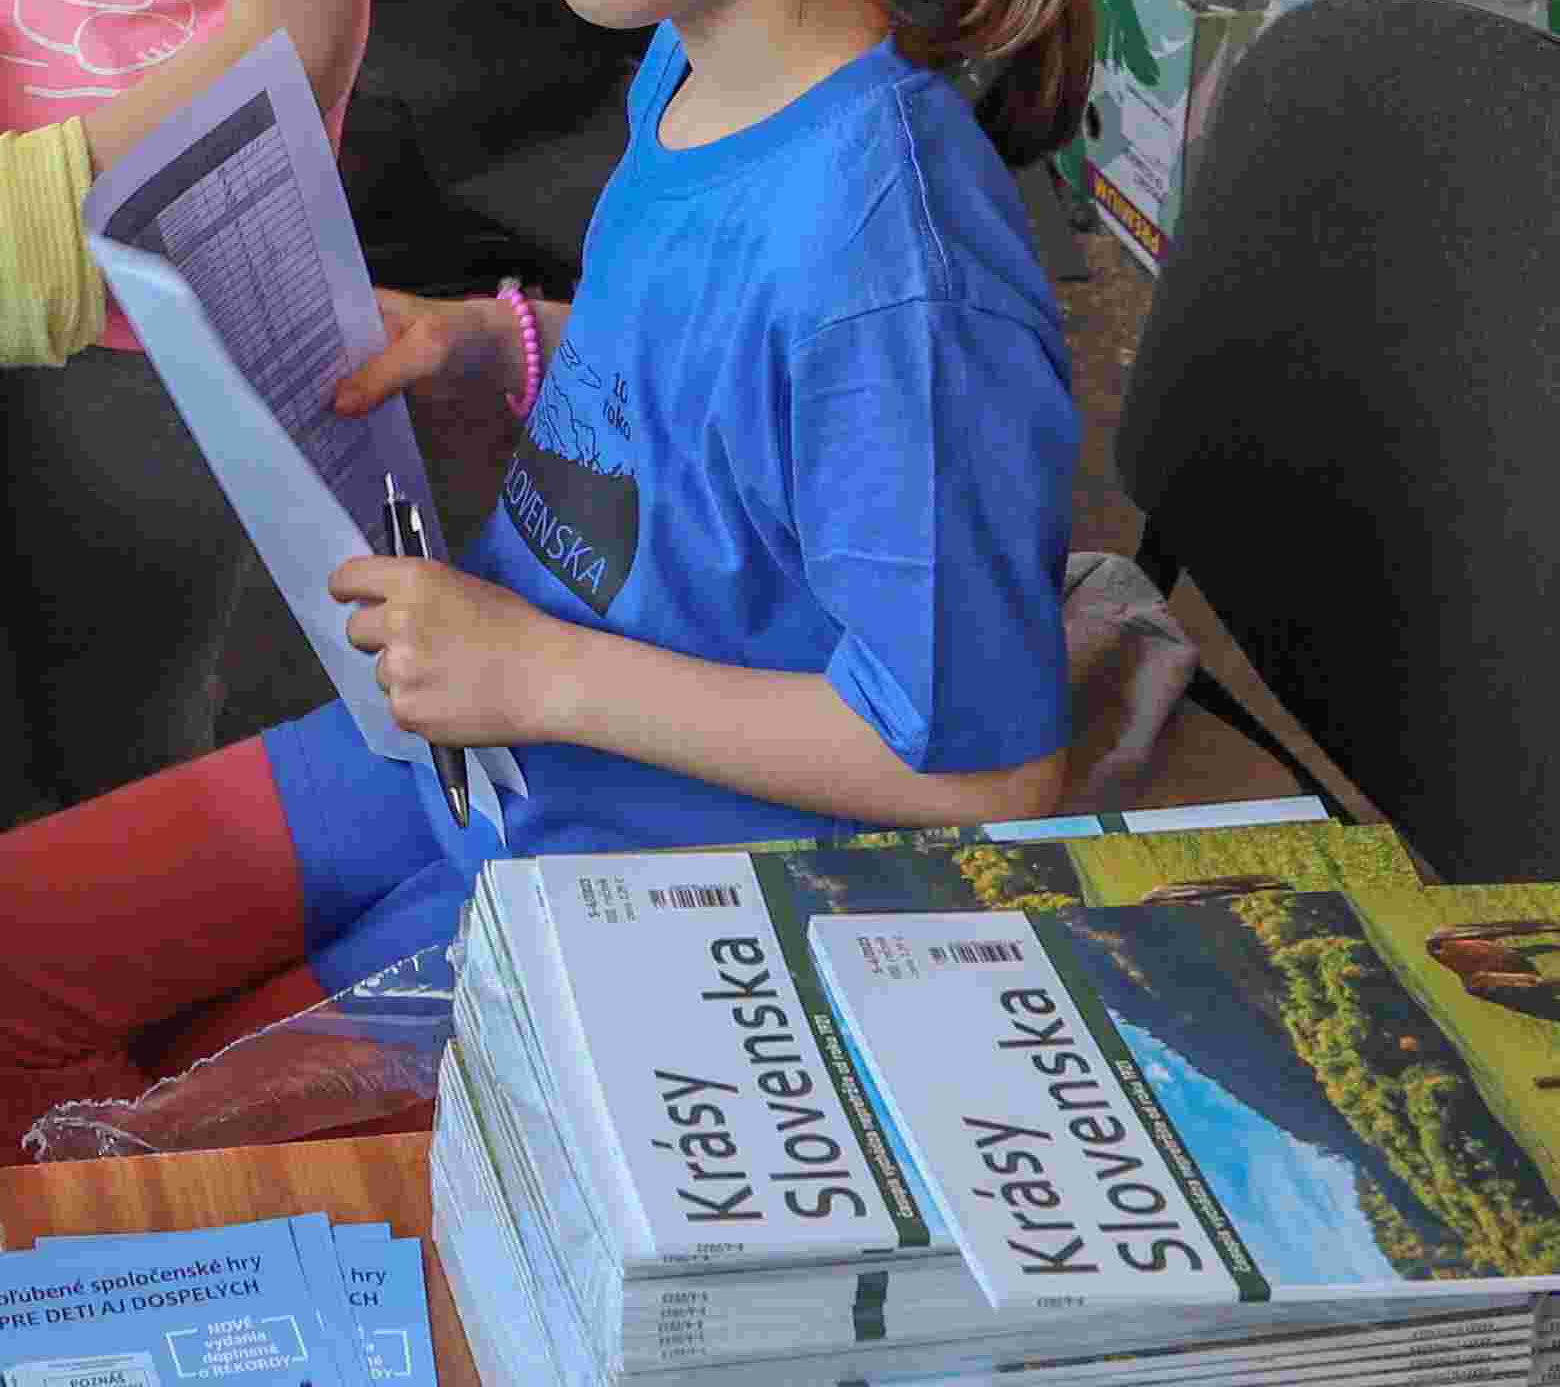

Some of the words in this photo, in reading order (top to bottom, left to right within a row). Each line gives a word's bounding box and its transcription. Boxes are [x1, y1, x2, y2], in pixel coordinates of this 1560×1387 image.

[650, 1065, 764, 1224] Krásy
[701, 934, 867, 1219] Slovenska
[996, 985, 1203, 1274] Slovenska
[961, 1114, 1098, 1276] Krásy
[45, 1302, 96, 1324] DETI
[101, 1298, 127, 1316] AJ
[131, 1279, 260, 1310] DOSPELÝCH
[90, 1260, 222, 1297] spoločenské
[224, 1253, 262, 1278] hry
[350, 1266, 387, 1287] hry
